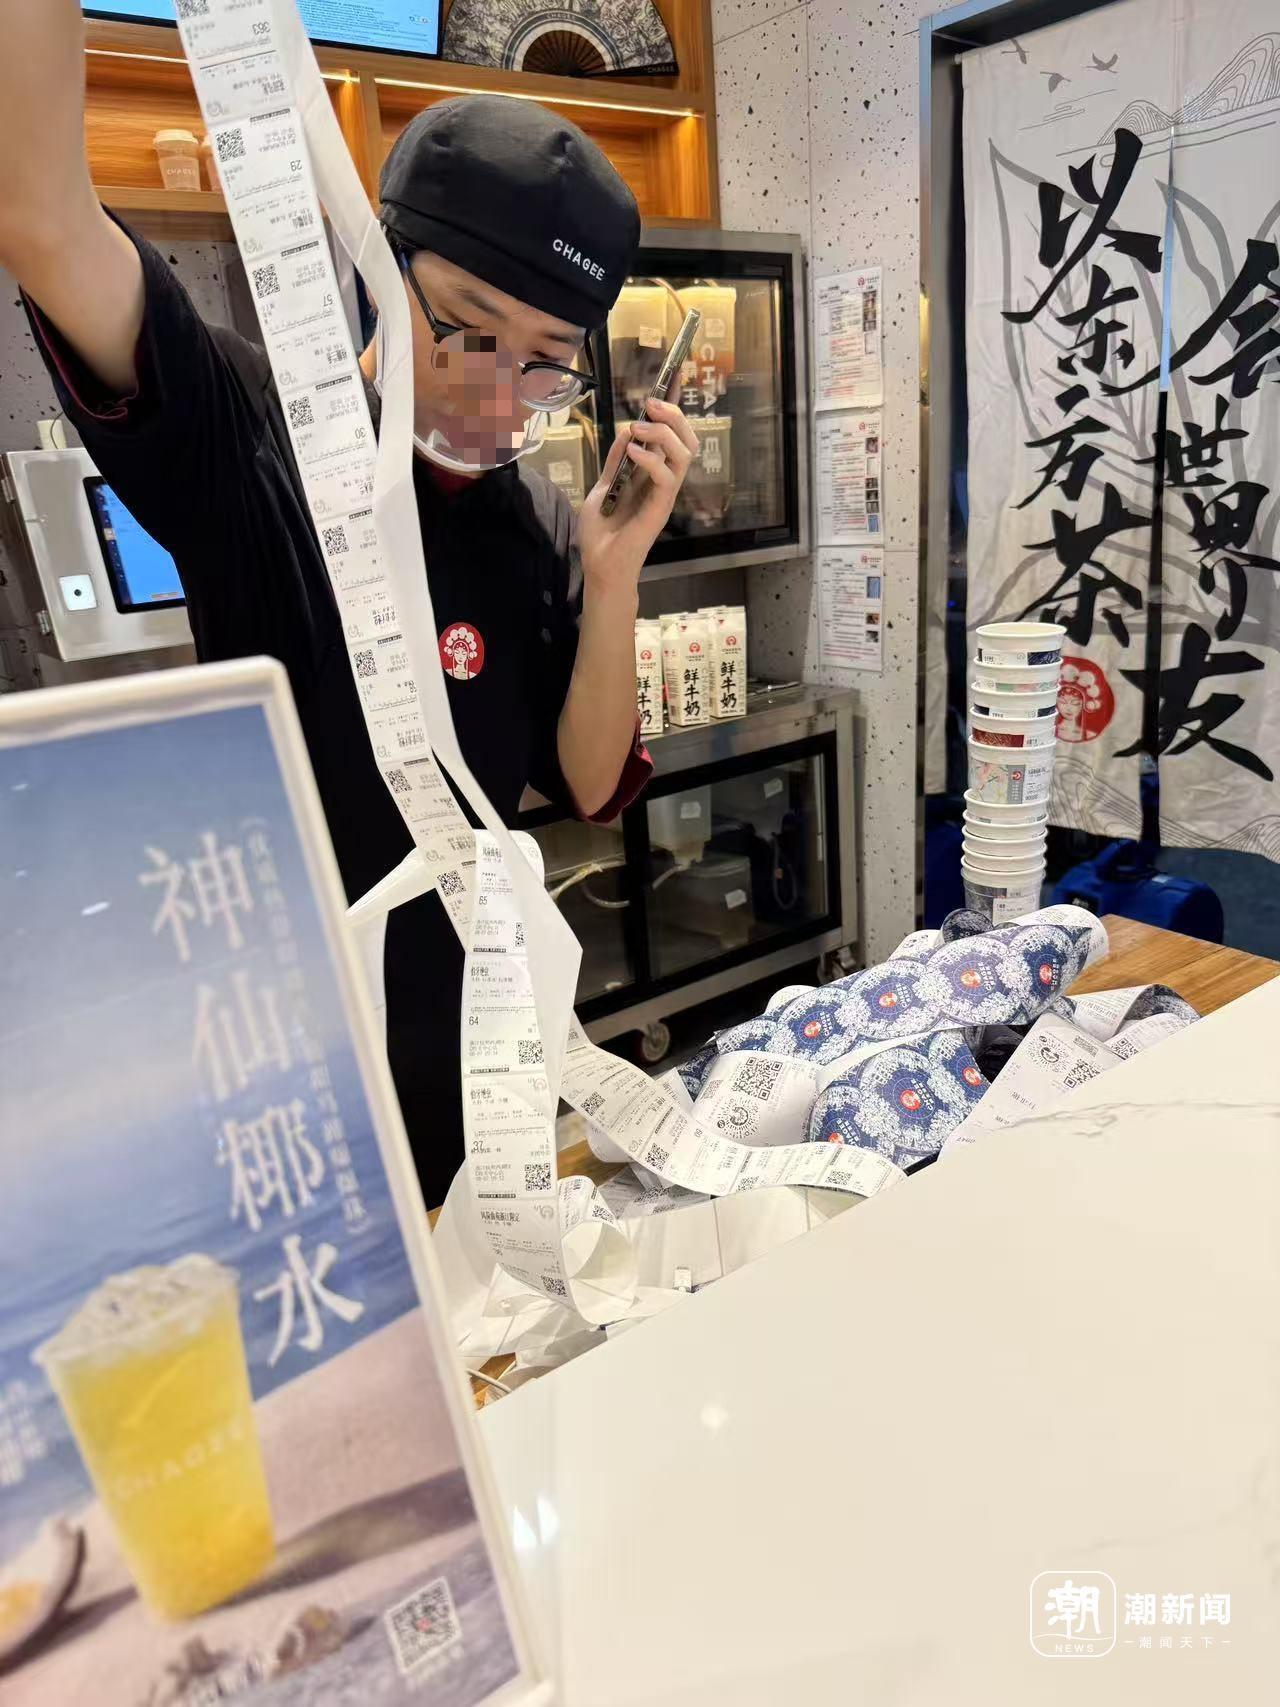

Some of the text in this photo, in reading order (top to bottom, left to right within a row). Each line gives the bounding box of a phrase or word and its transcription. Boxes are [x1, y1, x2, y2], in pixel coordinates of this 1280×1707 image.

[252, 22, 270, 35] 363
[552, 238, 605, 281] CHAGEE
[323, 294, 333, 307] 57
[1001, 127, 1163, 648] 以东方茶
[355, 427, 367, 439] 30
[720, 661, 737, 709] 鲜牛奶
[684, 668, 700, 717] 鲜牛奶
[479, 896, 488, 905] 65
[469, 1016, 479, 1025] 64
[139, 831, 365, 1367] 神仙椰水
[473, 1141, 484, 1151] 37
